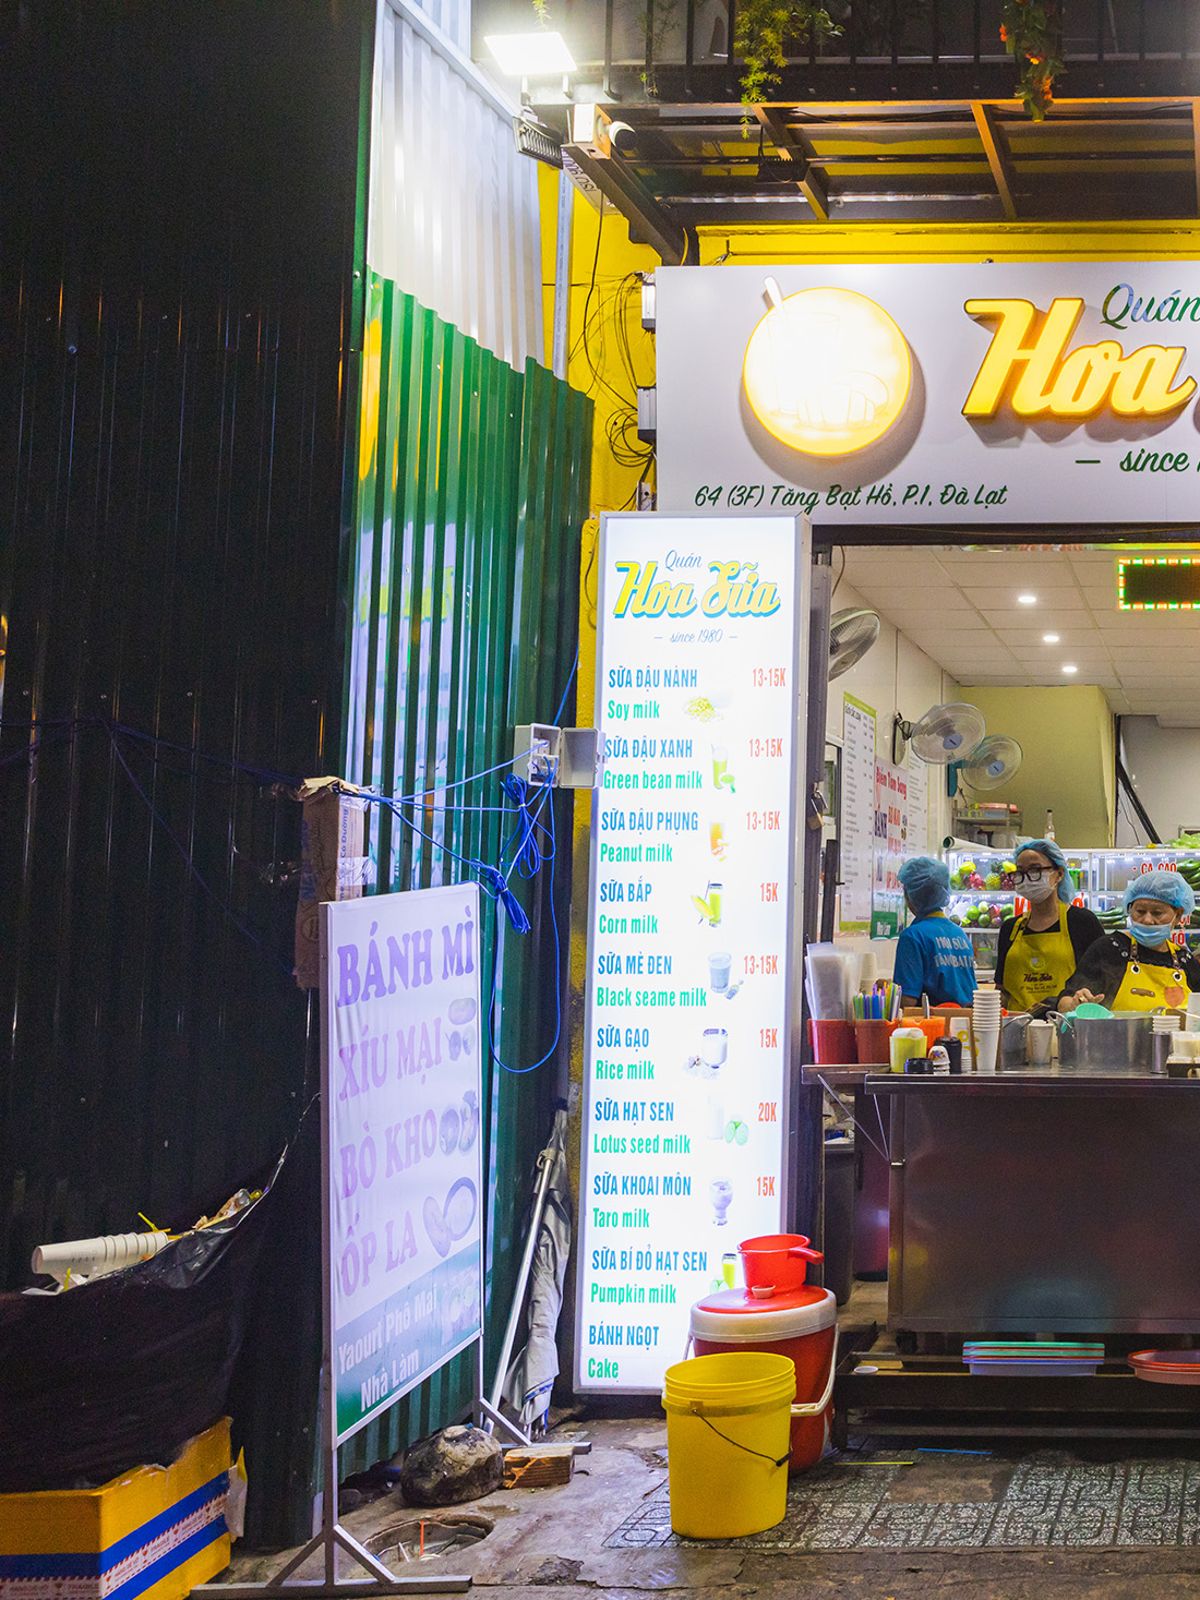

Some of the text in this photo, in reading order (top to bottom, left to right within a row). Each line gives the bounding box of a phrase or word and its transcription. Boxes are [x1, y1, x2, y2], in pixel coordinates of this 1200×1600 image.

[962, 298, 1198, 420] Hoa
[1119, 448, 1190, 472] since
[695, 485, 723, 507] 64
[727, 485, 765, 508] (3F)
[770, 485, 820, 515] Tăng
[826, 484, 862, 510] Bạt
[940, 485, 969, 506] Đà
[974, 484, 1008, 509] Lạt
[664, 549, 702, 571] Quán
[613, 560, 781, 619] Hoa Sữa
[669, 628, 724, 645] since 1980
[608, 665, 633, 688] SỮA
[636, 665, 660, 692] ĐẬU
[753, 667, 786, 687] 13-15K
[607, 700, 660, 721] Soy milk
[605, 735, 693, 762] SỮA ĐẬU XANH
[749, 738, 783, 758] 13-15K
[604, 770, 703, 789] Green bean milk
[601, 808, 699, 835] SỮA ĐẬU PHỤNG
[746, 811, 781, 830] 13-15K
[600, 843, 673, 862] Peanut milk
[600, 875, 653, 902] SỮA BẮP
[760, 882, 779, 902] 15K
[599, 914, 658, 934] Corn milk
[336, 905, 475, 1008] BÁNH MÌ
[598, 951, 623, 975] SỮA
[647, 955, 672, 975] ĐEN
[744, 955, 779, 975] 13-15K
[596, 986, 707, 1007] Black seame milk
[597, 1024, 649, 1052] SỮA GẠO
[760, 1028, 778, 1048] 15K
[339, 1016, 442, 1103] XÍU MẠI
[595, 1059, 655, 1080] Rice milk
[595, 1098, 674, 1126] SỮA HẠT SEN
[758, 1102, 777, 1122] 20K
[340, 1108, 437, 1201] BÒ KHO
[593, 1133, 691, 1154] Lotus seed milk
[593, 1171, 618, 1196] SỮA
[622, 1175, 659, 1196] KHOAI
[757, 1176, 776, 1196] 15K
[593, 1208, 650, 1228] Taro milk
[341, 1209, 418, 1298] ỐP LA
[592, 1244, 707, 1275] SỮA BÍ ĐỎ HẠT SEN
[591, 1283, 676, 1305] Pumpkin milk
[338, 1284, 437, 1375] Yaourt Phô Mai
[589, 1321, 659, 1350] BÁNH NGỌT
[588, 1357, 619, 1378] Cake
[360, 1349, 419, 1412] Nhà Làm
